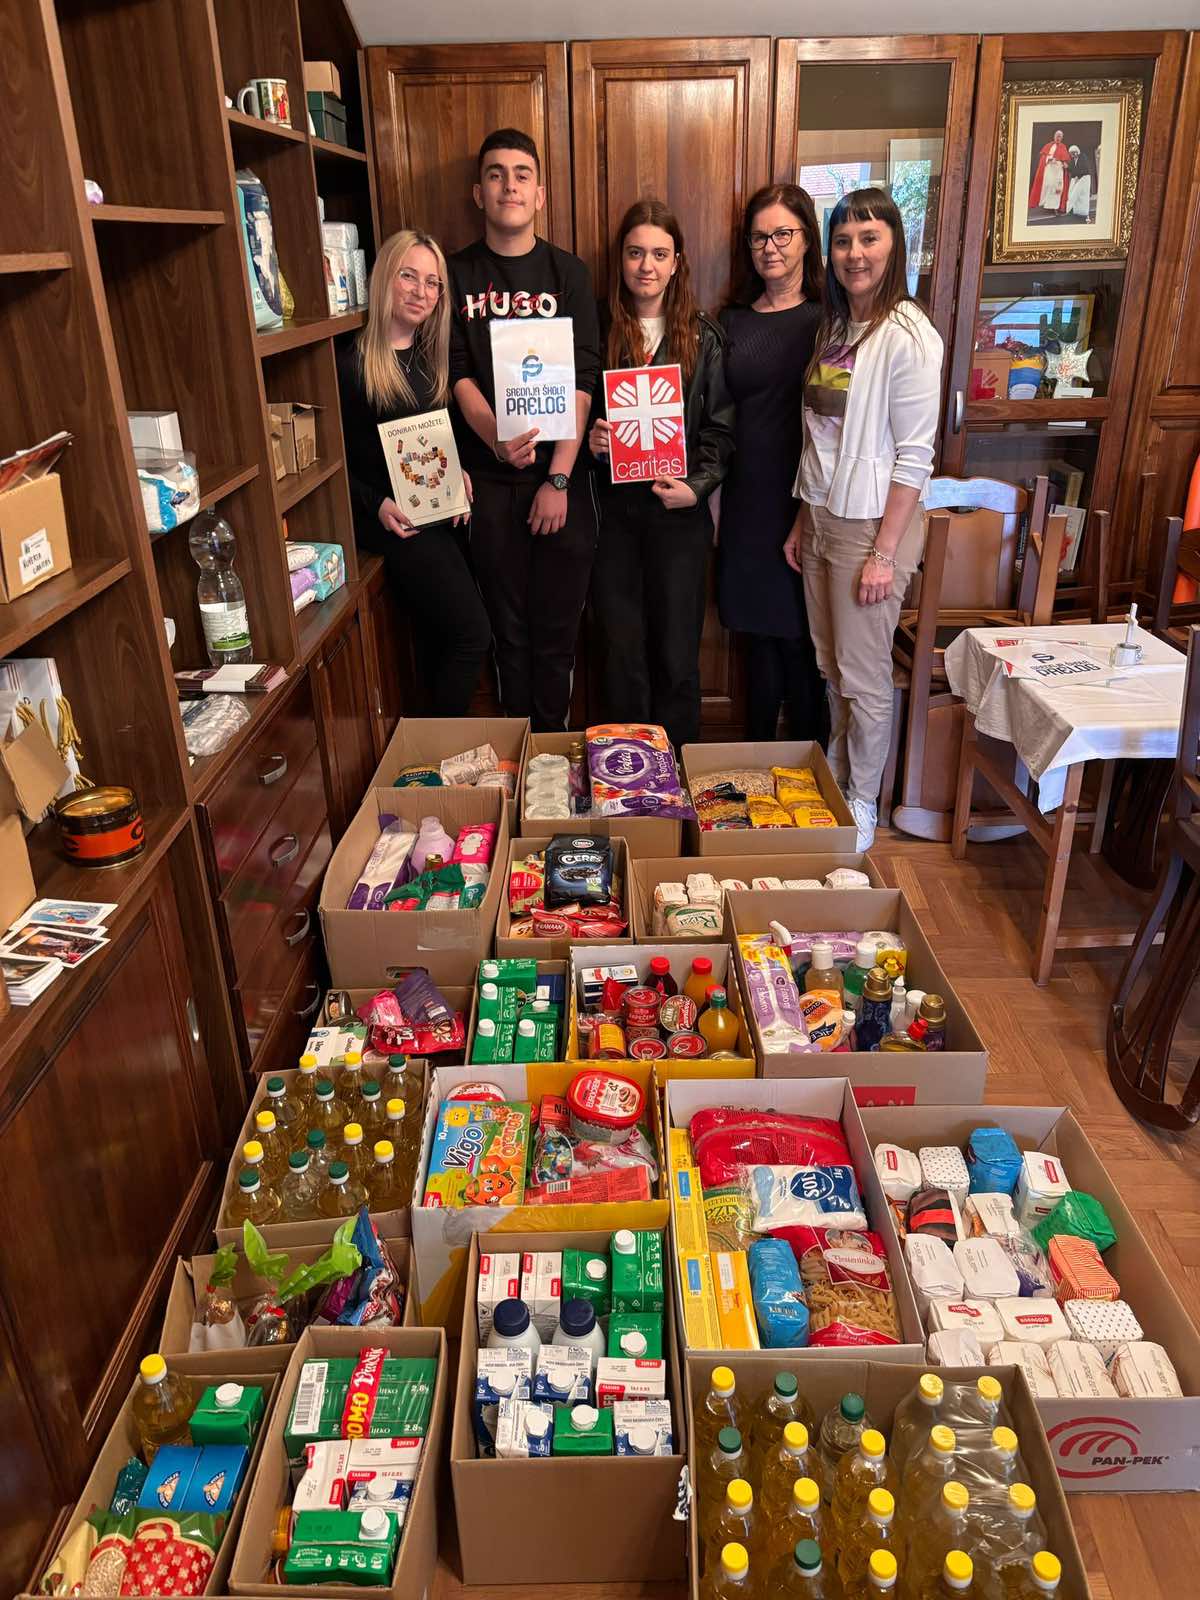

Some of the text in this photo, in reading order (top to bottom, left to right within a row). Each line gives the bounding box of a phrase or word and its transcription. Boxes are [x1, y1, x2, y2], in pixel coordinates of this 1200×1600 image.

[465, 290, 558, 319] HUGO
[542, 384, 566, 396] ŠKOLA
[505, 395, 567, 416] PRELOG
[615, 455, 683, 479] caritas
[442, 1127, 484, 1168] Vigo
[802, 1173, 820, 1199] SOL
[346, 1391, 370, 1440] ROMO
[1091, 1455, 1164, 1466] PAN-PEK
